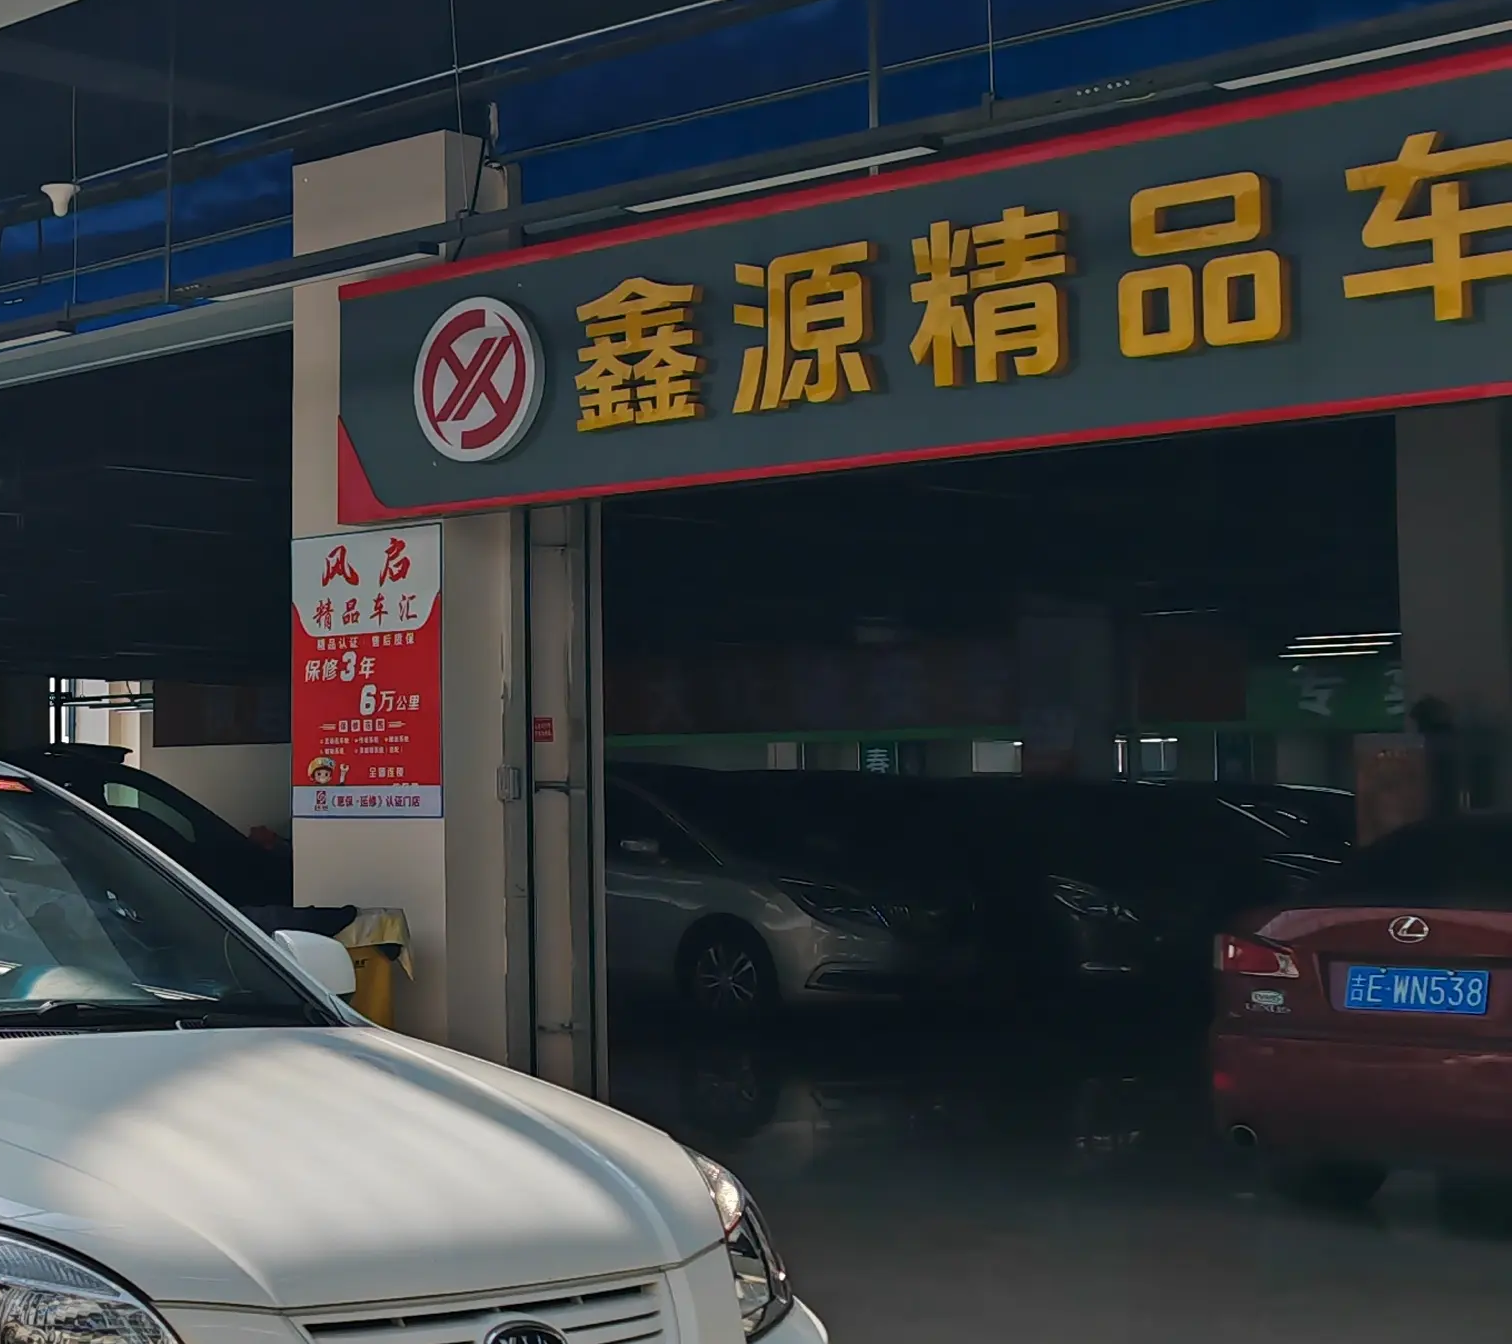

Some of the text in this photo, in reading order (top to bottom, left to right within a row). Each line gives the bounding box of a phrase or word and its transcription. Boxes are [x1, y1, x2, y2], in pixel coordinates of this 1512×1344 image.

[575, 130, 1512, 433] 鑫源精品车
[321, 537, 412, 588] 风启
[312, 592, 419, 632] 精品车汇
[304, 651, 376, 683] 保修3年
[359, 684, 420, 716] 6万公里
